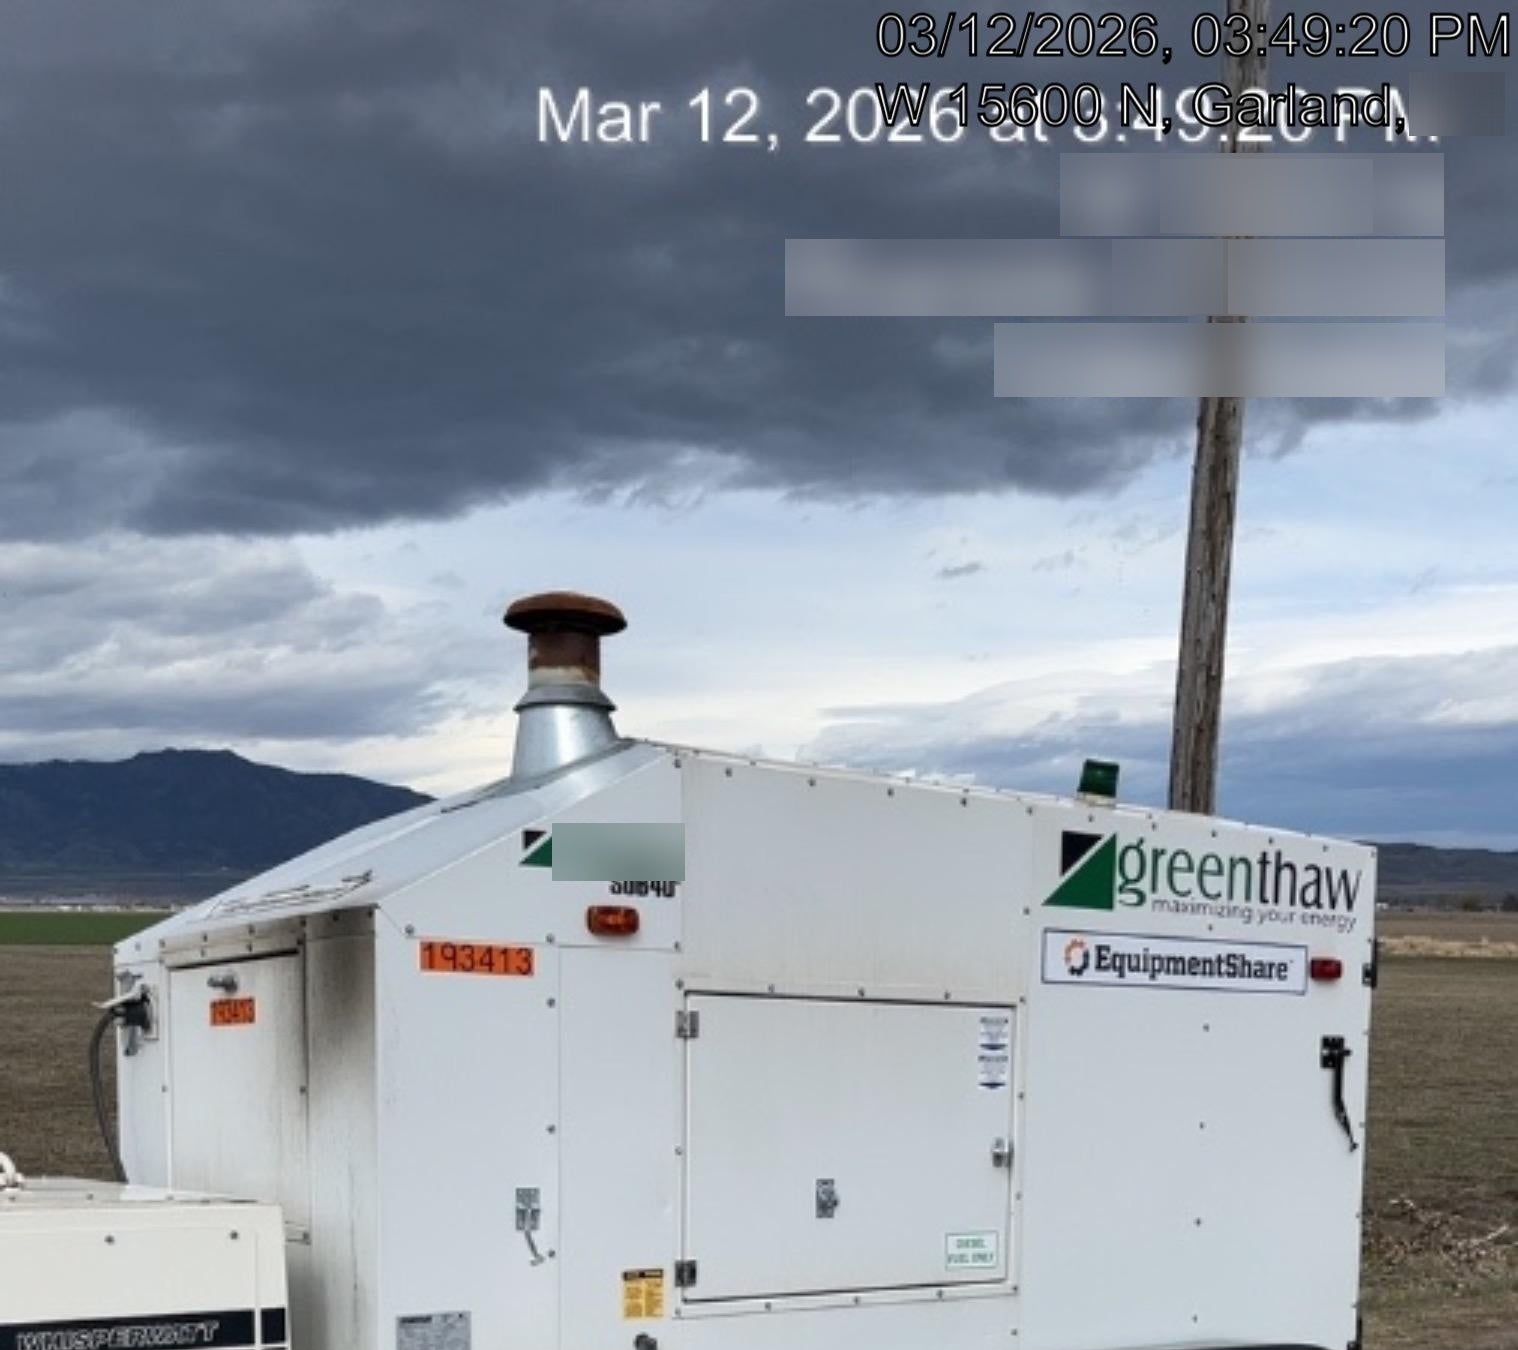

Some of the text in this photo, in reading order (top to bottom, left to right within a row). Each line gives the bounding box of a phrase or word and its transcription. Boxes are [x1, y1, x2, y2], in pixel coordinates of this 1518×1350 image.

[1117, 836, 1362, 912] greenthaw
[1151, 898, 1358, 934] maximizing your energy
[422, 941, 533, 976] 193413
[1093, 943, 1289, 982] EquipmentShare
